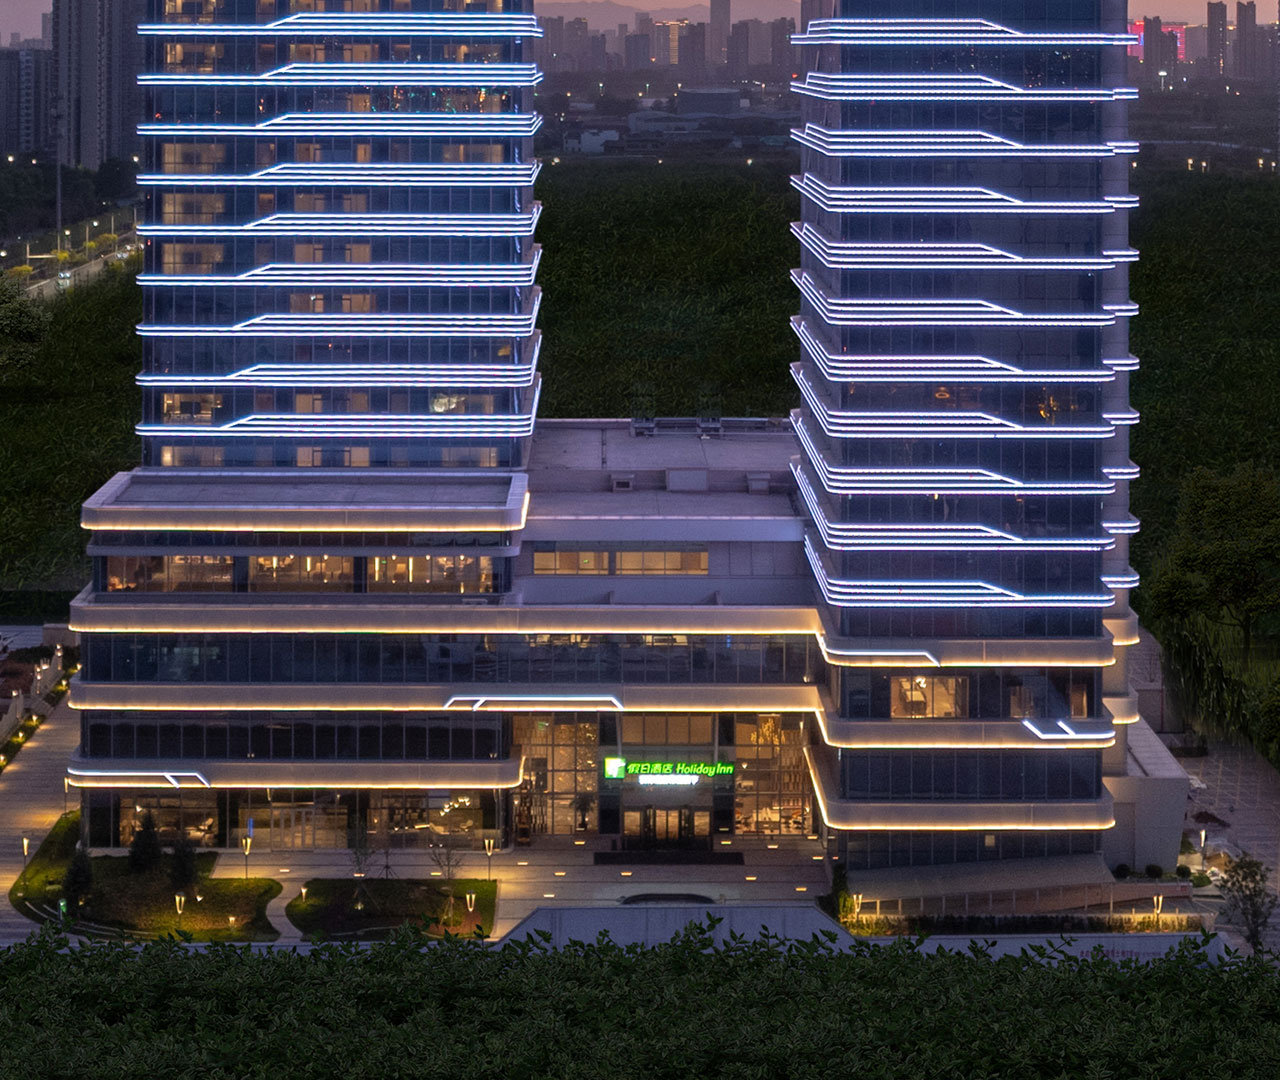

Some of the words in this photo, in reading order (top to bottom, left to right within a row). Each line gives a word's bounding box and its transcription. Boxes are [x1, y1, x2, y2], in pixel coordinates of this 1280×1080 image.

[627, 762, 673, 774] 假日酒店
[676, 762, 716, 776] Holiday
[716, 763, 733, 774] Inn
